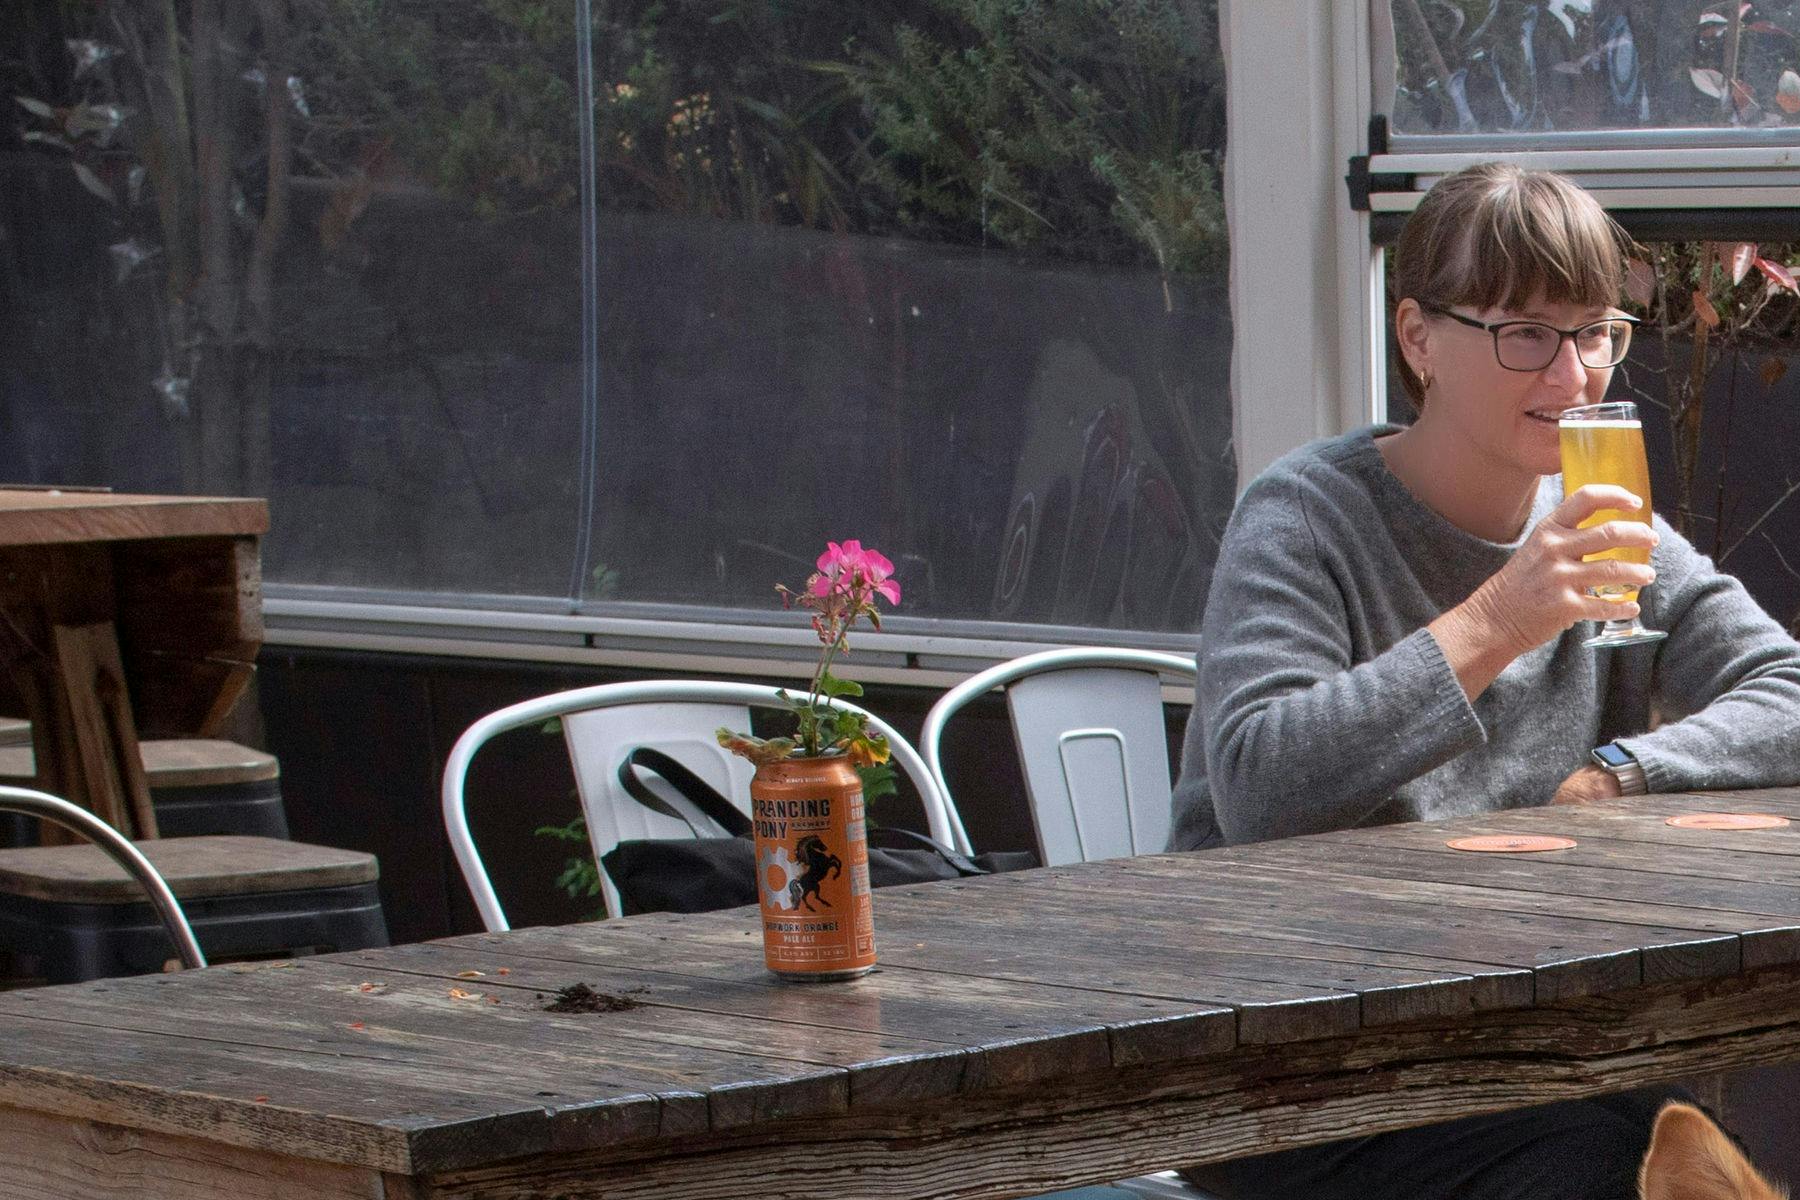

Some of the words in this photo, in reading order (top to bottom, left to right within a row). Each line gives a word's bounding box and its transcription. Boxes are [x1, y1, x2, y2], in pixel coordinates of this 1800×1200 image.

[753, 798, 831, 818] PRANCING
[754, 819, 788, 839] PONY
[804, 921, 839, 932] ORANGE
[784, 934, 800, 944] PALE
[802, 934, 815, 944] ALE
